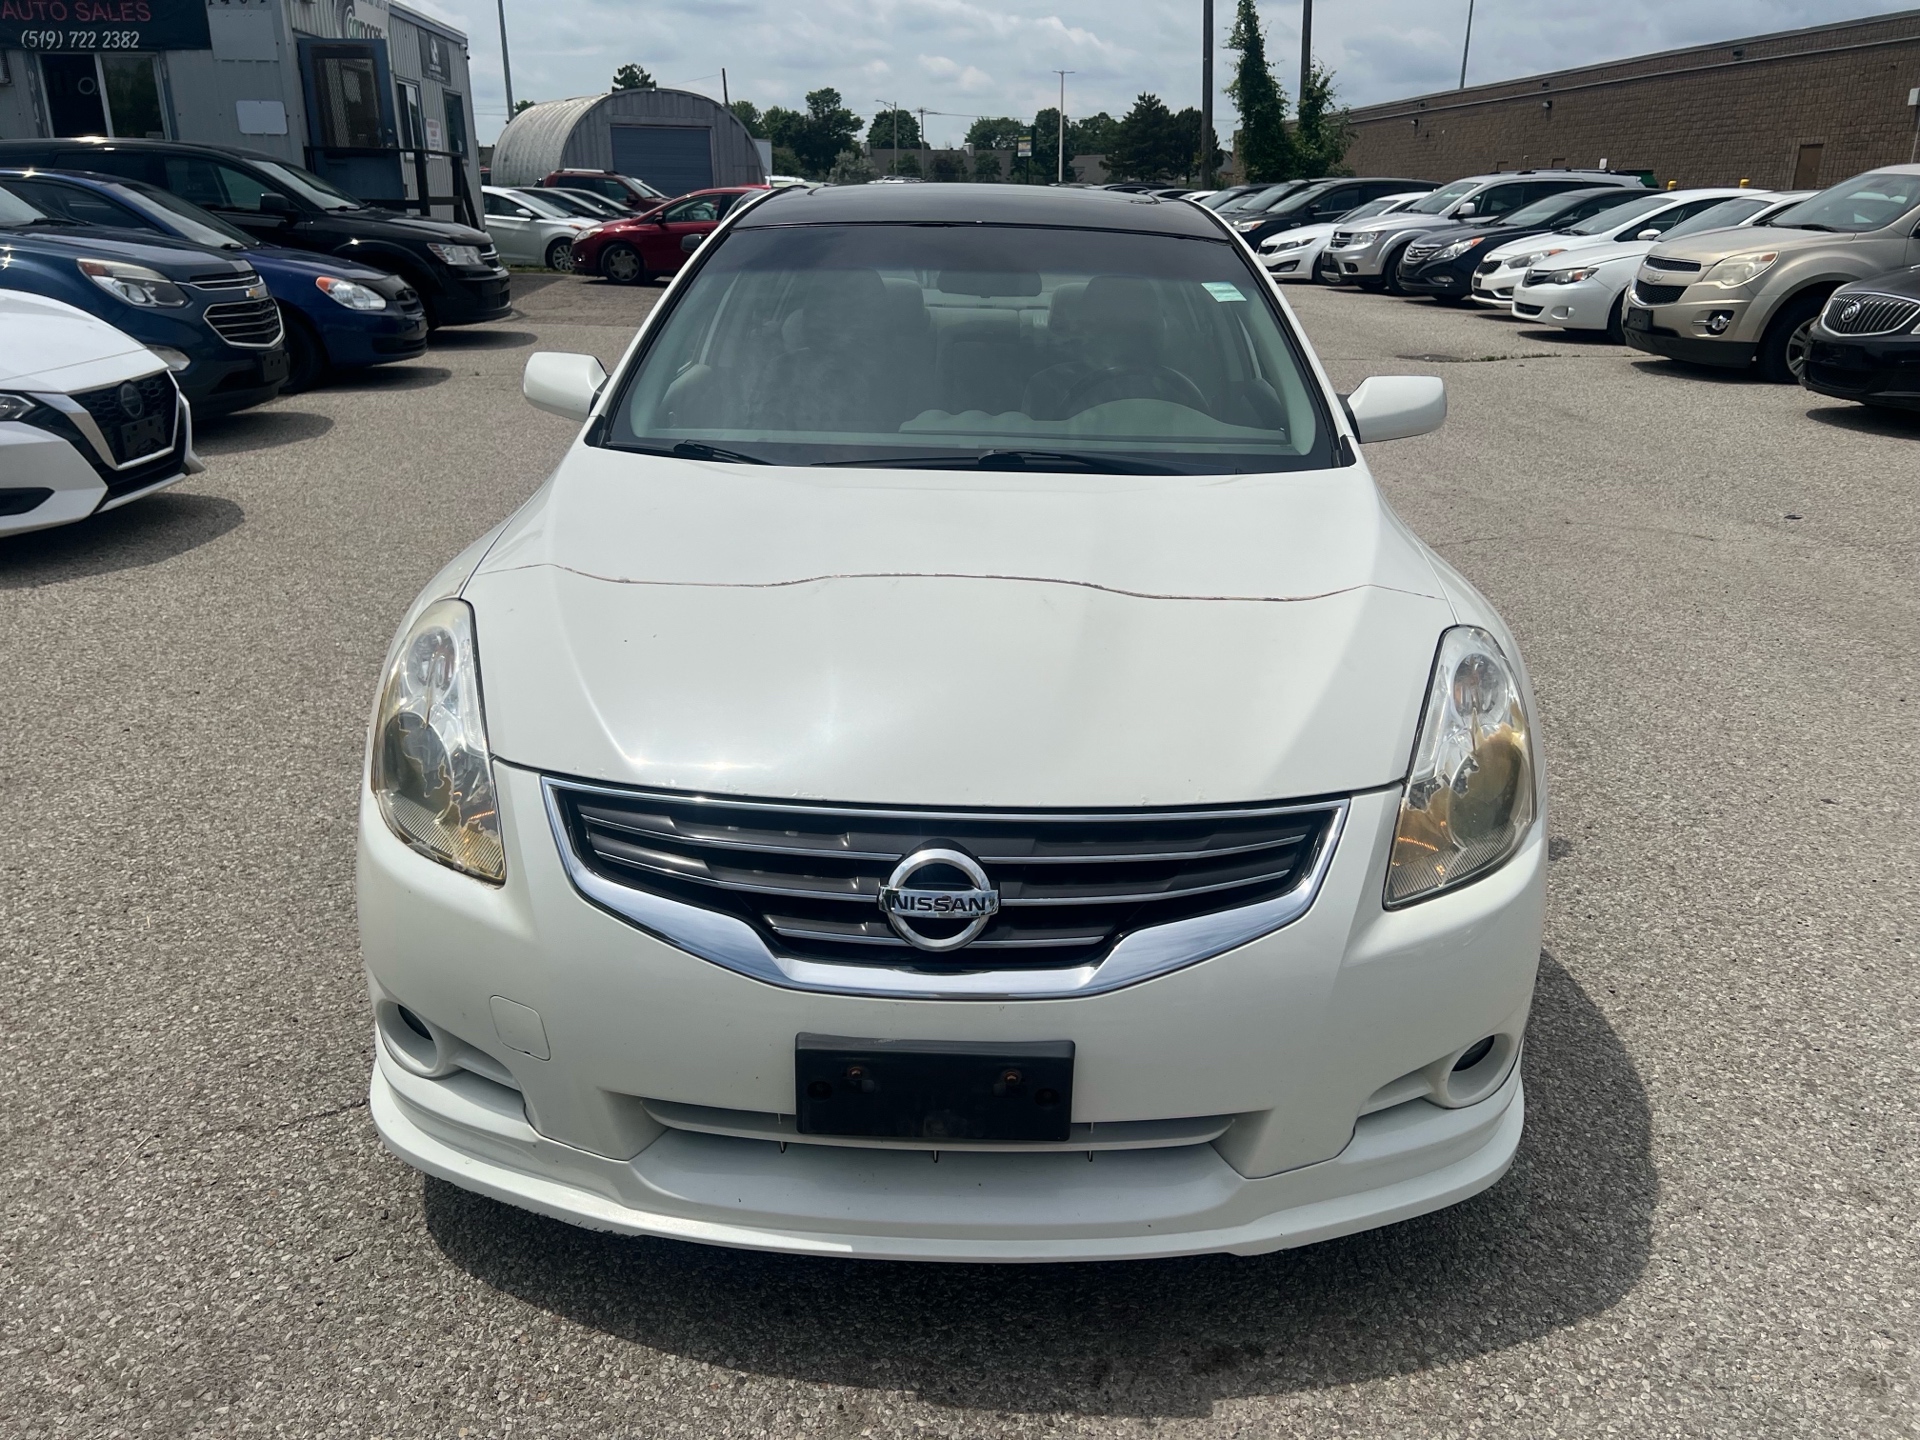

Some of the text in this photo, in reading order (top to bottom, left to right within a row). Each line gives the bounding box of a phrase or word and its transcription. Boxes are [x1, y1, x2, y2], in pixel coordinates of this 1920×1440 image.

[2, 1, 151, 22] AUTO SALES
[21, 30, 140, 49] (519) 722 2382
[890, 894, 986, 912] NISSAN
